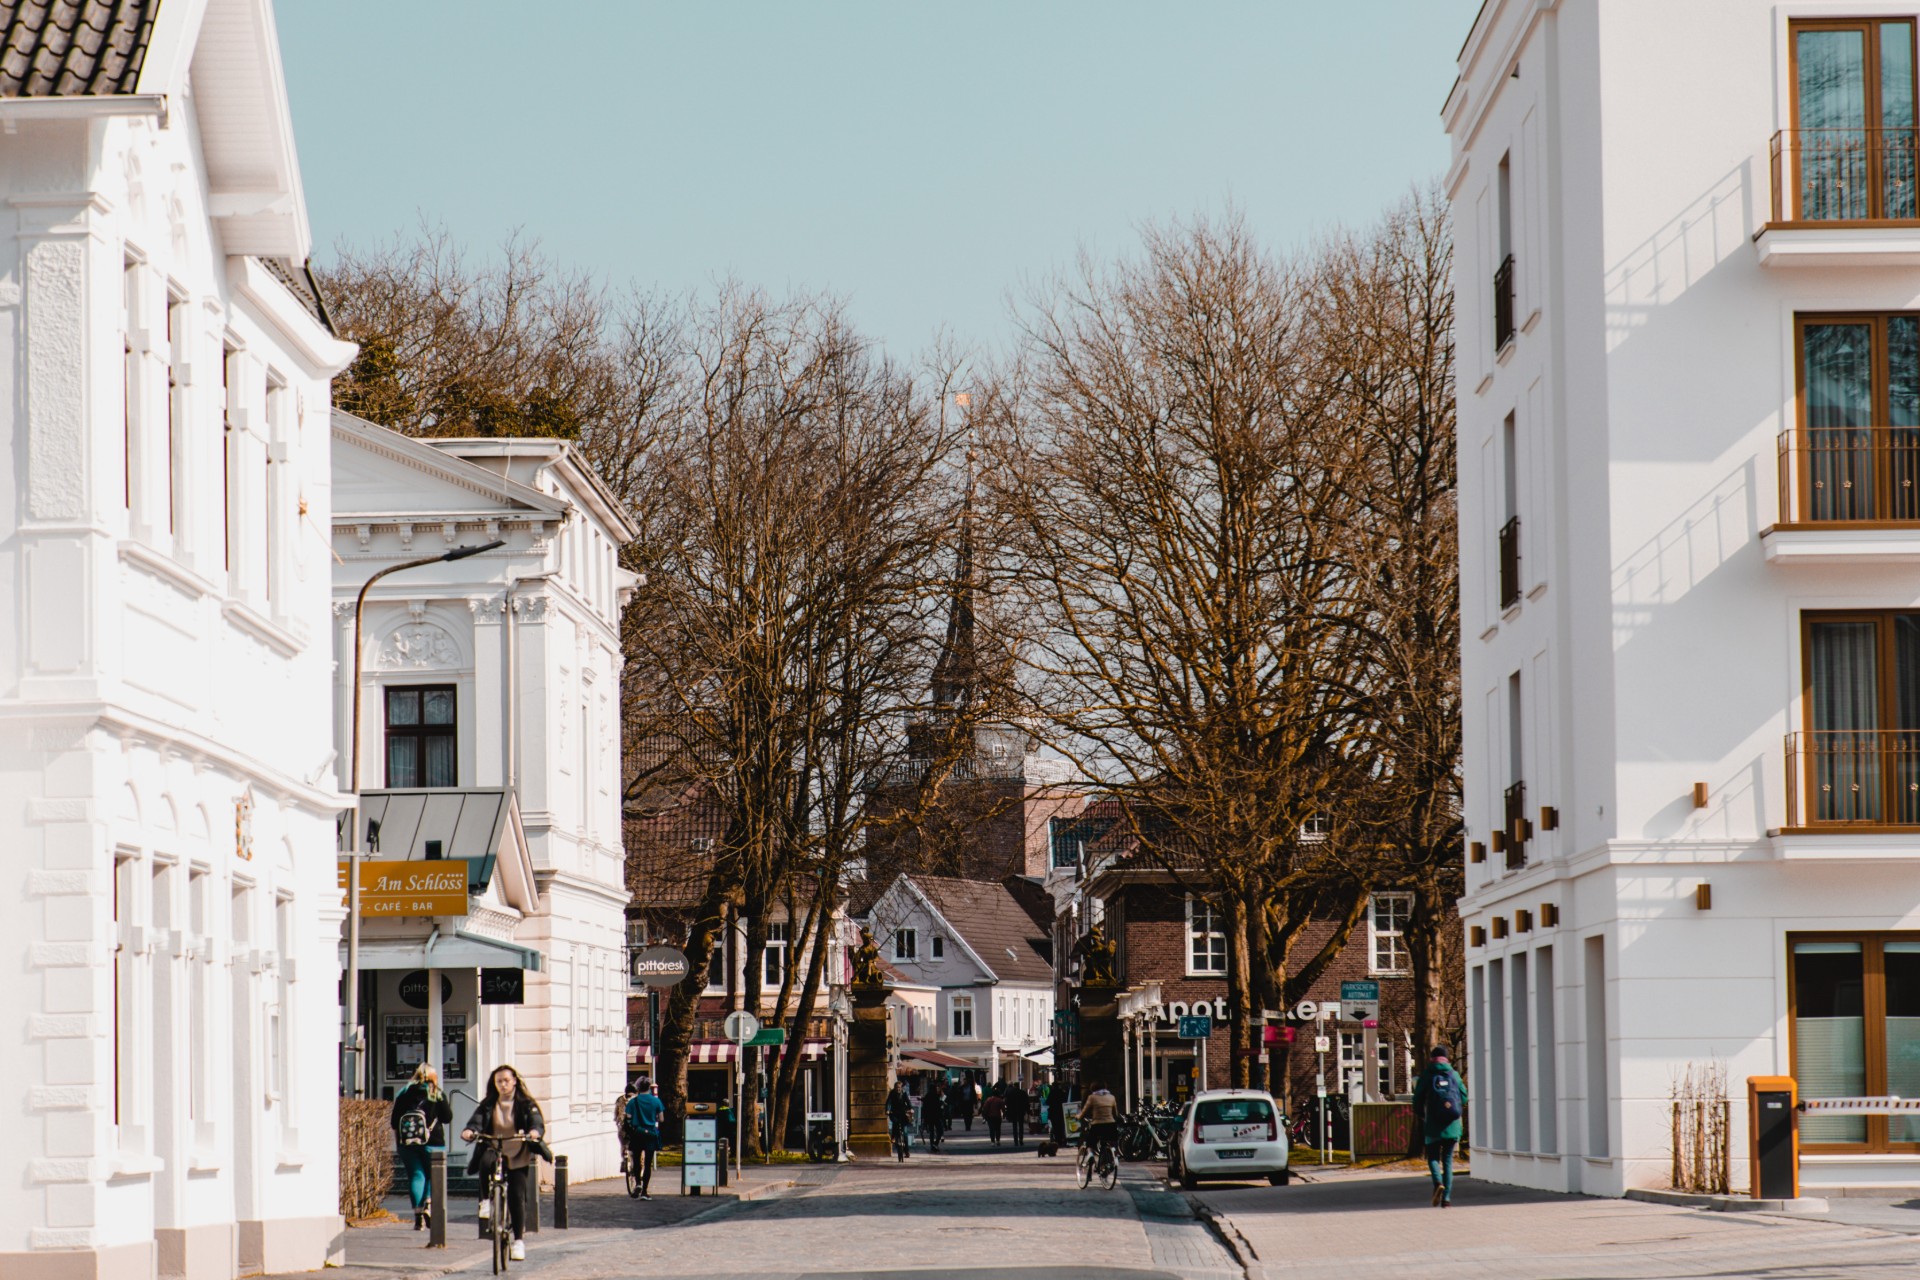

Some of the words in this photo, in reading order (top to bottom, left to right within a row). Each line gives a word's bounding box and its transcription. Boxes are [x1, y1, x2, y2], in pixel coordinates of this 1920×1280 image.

[374, 876, 402, 892] Am
[405, 873, 463, 891] Schloss
[374, 901, 401, 912] CAFÉ
[412, 902, 433, 911] BAR
[637, 959, 684, 976] pittoresk
[403, 983, 448, 998] pittok
[486, 976, 518, 995] sky
[392, 1016, 458, 1024] RESTANT
